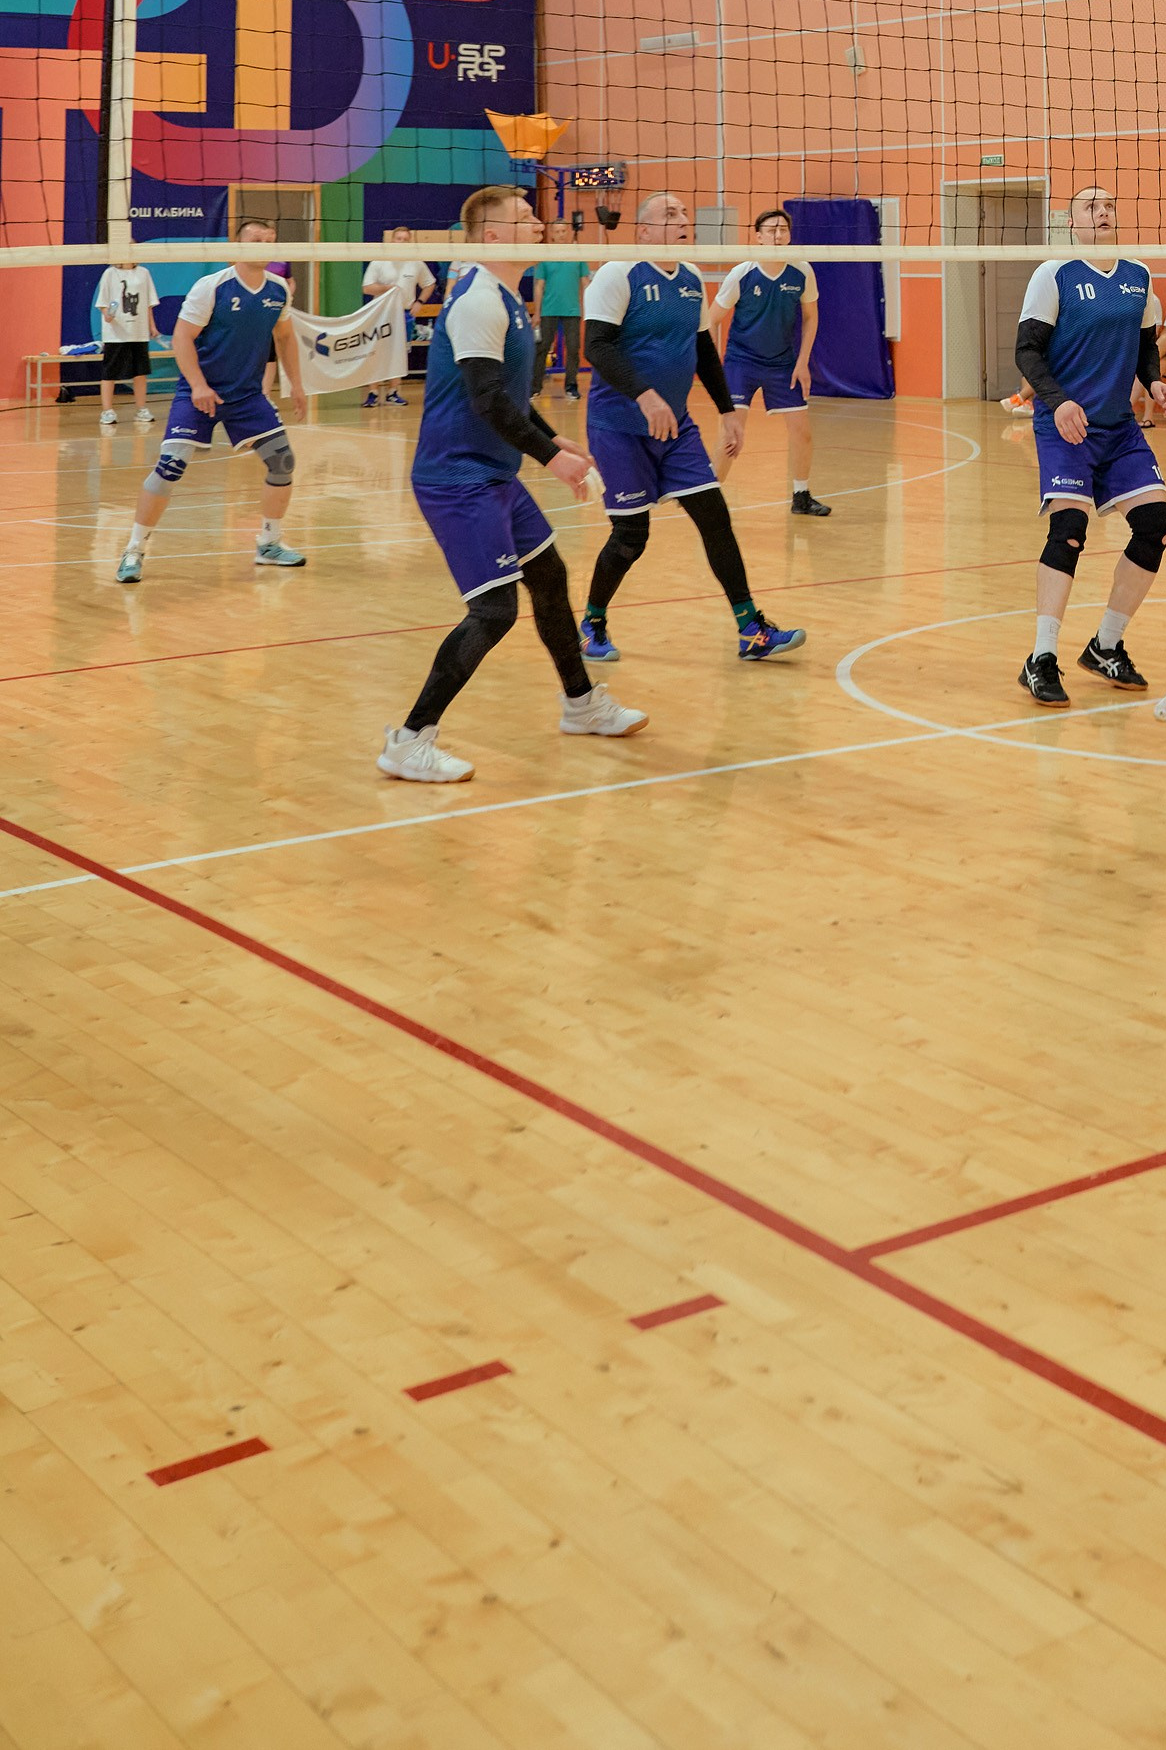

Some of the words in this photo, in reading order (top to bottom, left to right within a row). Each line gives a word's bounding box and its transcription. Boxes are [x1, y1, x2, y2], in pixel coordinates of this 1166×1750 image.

[153, 207, 205, 218] КАБИНА
[642, 284, 660, 302] 11
[1075, 283, 1096, 300] 10
[231, 297, 241, 311] 2
[1151, 464, 1164, 482] 1
